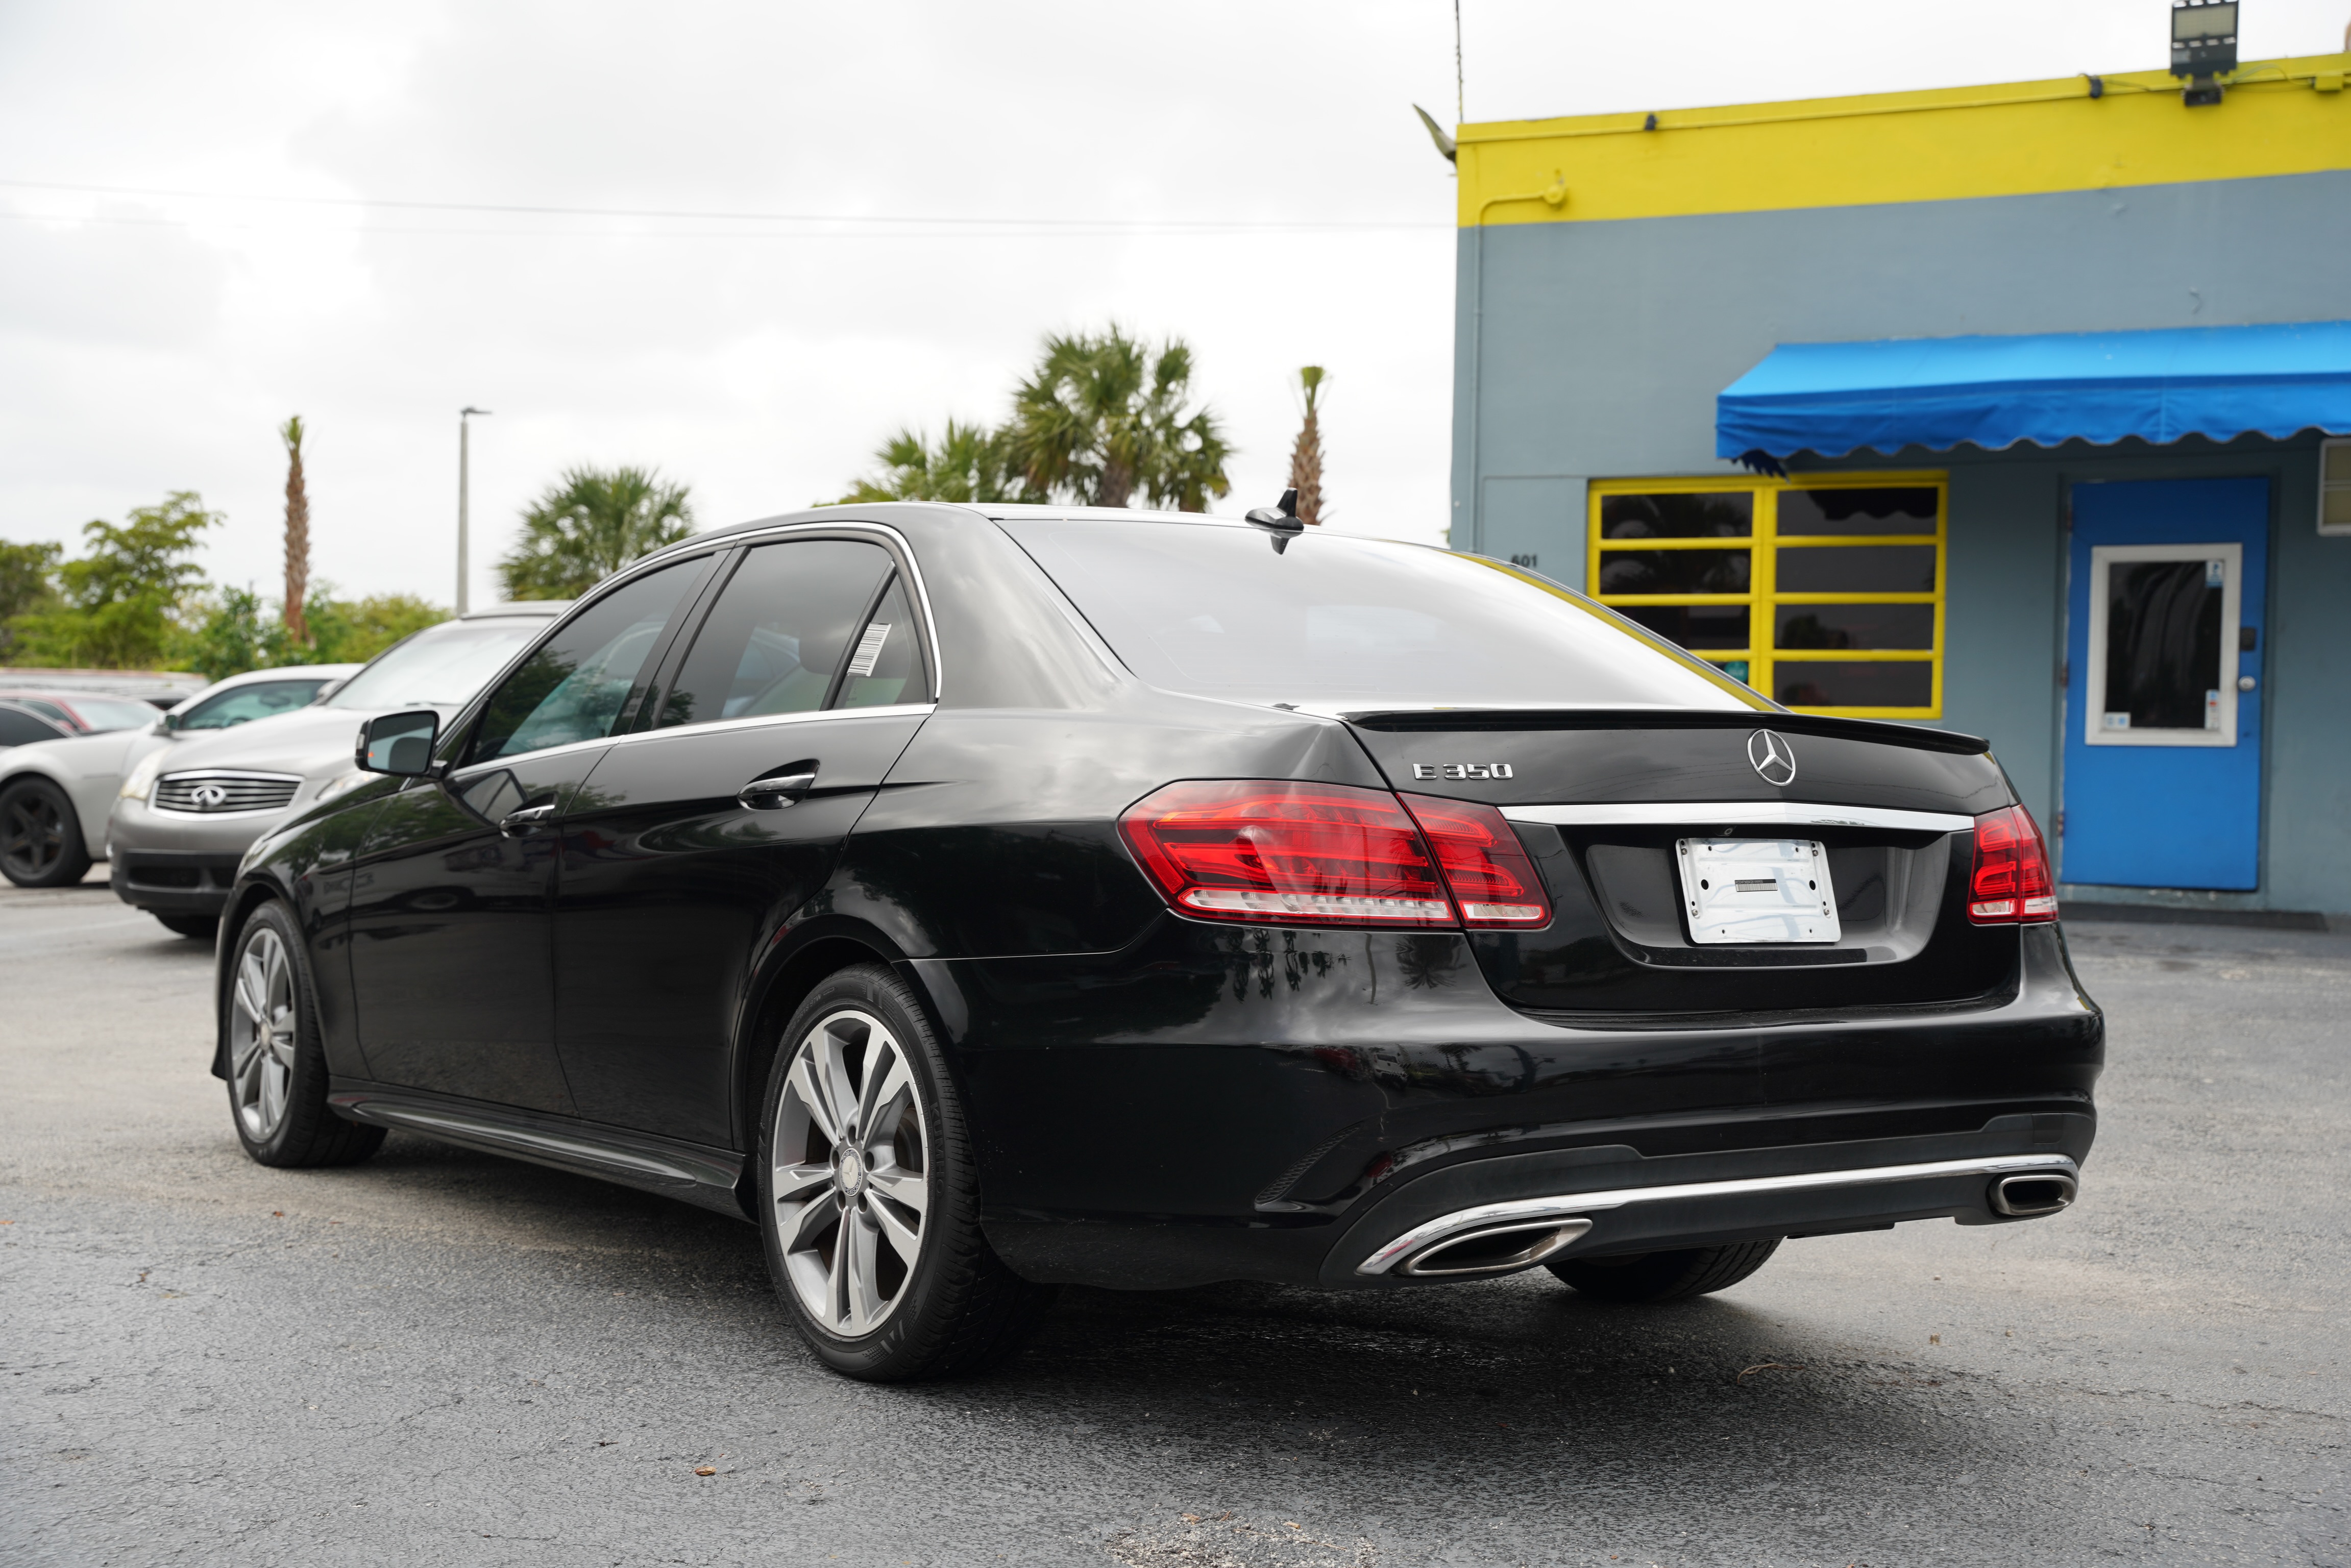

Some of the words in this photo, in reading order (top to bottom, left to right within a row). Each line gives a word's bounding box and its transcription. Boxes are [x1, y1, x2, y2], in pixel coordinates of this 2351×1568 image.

[1412, 763, 1437, 780] E
[1443, 763, 1513, 780] 350
[929, 1101, 945, 1194] KUMHO
